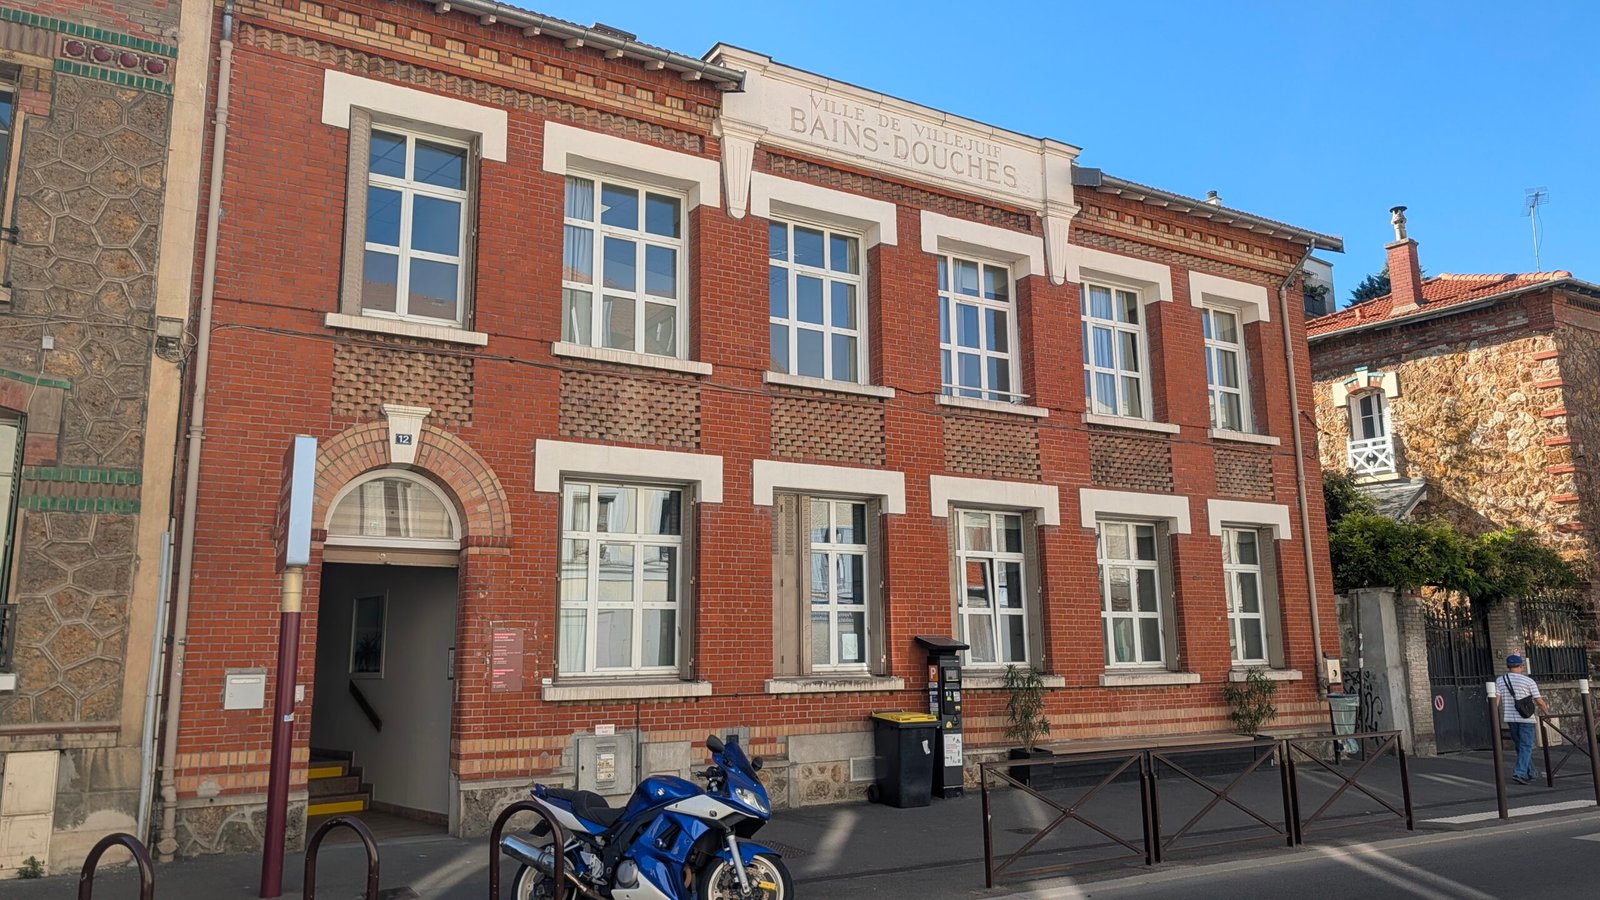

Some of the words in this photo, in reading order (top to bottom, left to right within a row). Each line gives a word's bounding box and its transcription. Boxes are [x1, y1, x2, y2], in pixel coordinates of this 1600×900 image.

[809, 95, 865, 121] VILLE
[878, 113, 901, 132] DE
[911, 123, 1002, 158] VILLEJUIF
[398, 435, 410, 444] 12
[930, 667, 937, 679] P
